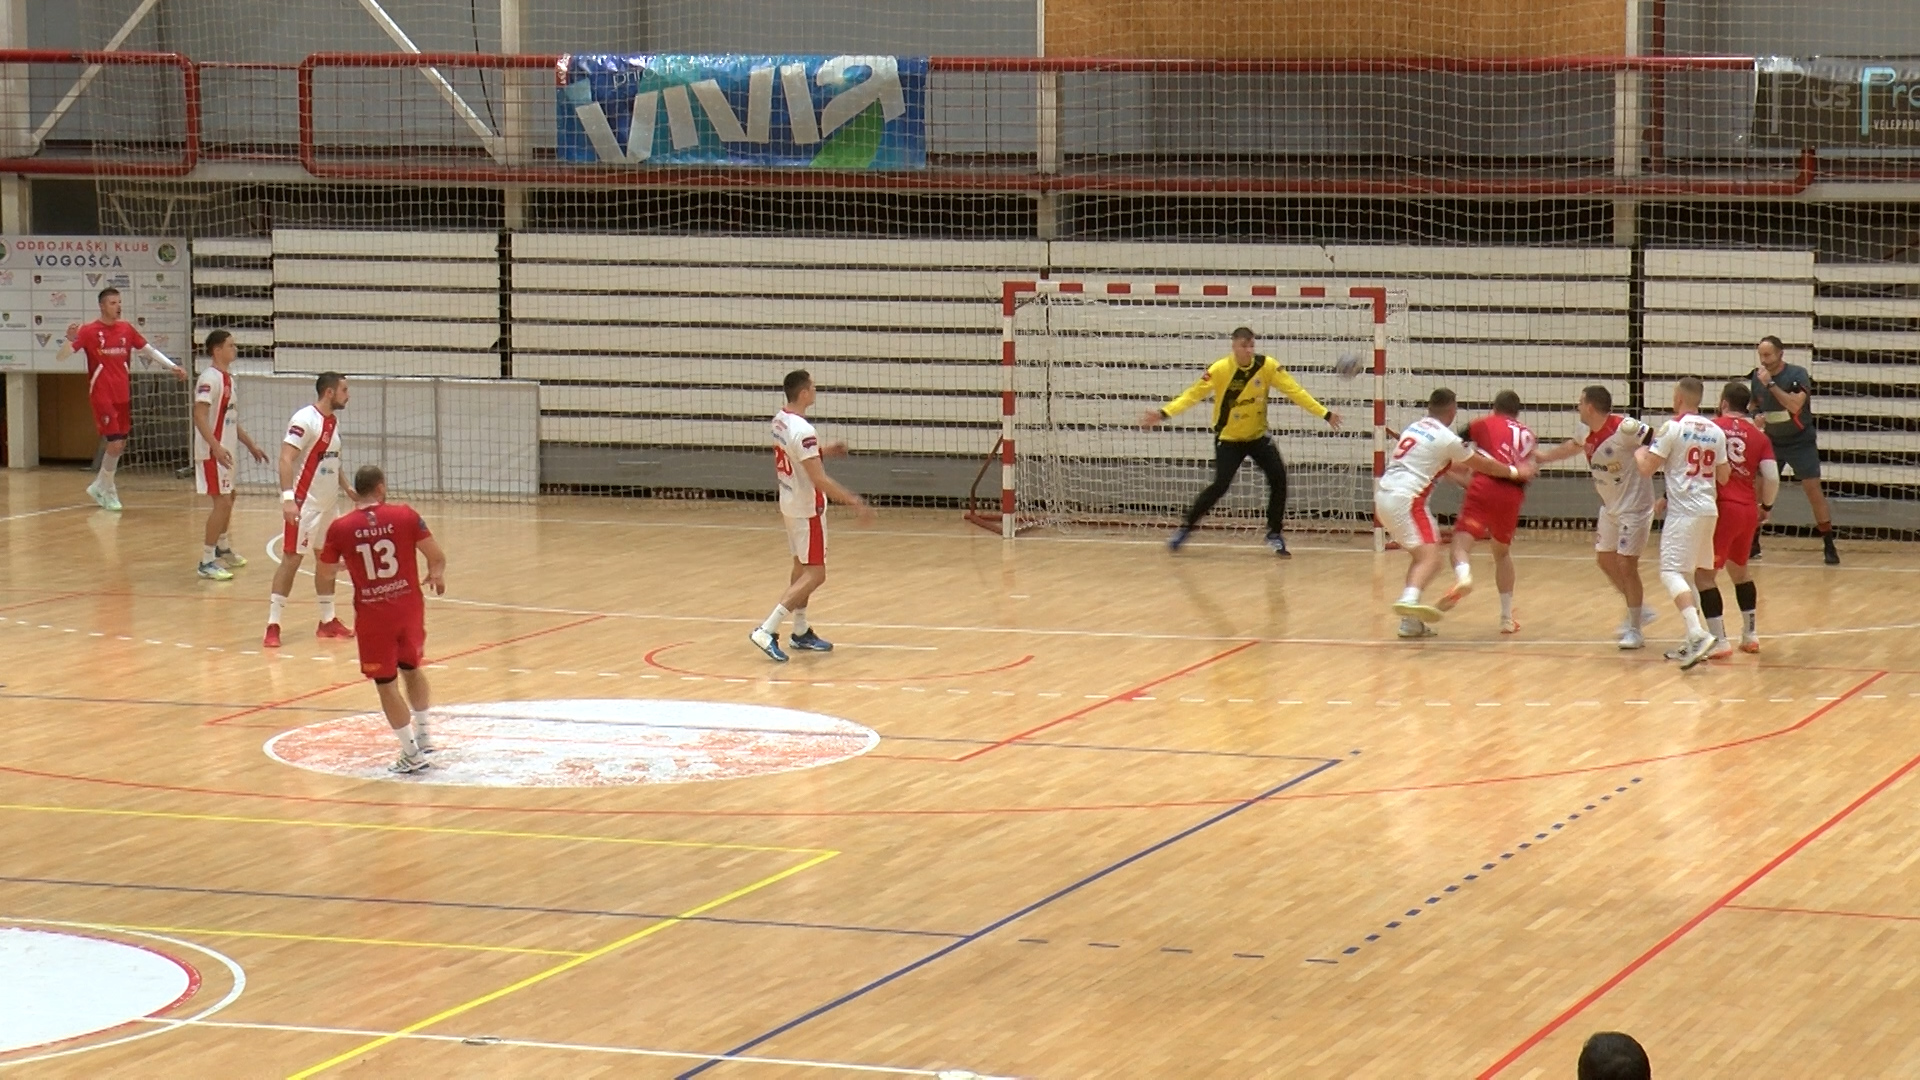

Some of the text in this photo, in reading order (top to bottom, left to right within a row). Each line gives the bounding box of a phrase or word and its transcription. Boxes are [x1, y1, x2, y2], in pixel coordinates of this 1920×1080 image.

[16, 240, 149, 252] ODBOJKAŠKI KLUB
[34, 252, 123, 268] VOGOŠĆA
[1393, 436, 1418, 460] 9
[355, 538, 399, 580] 13
